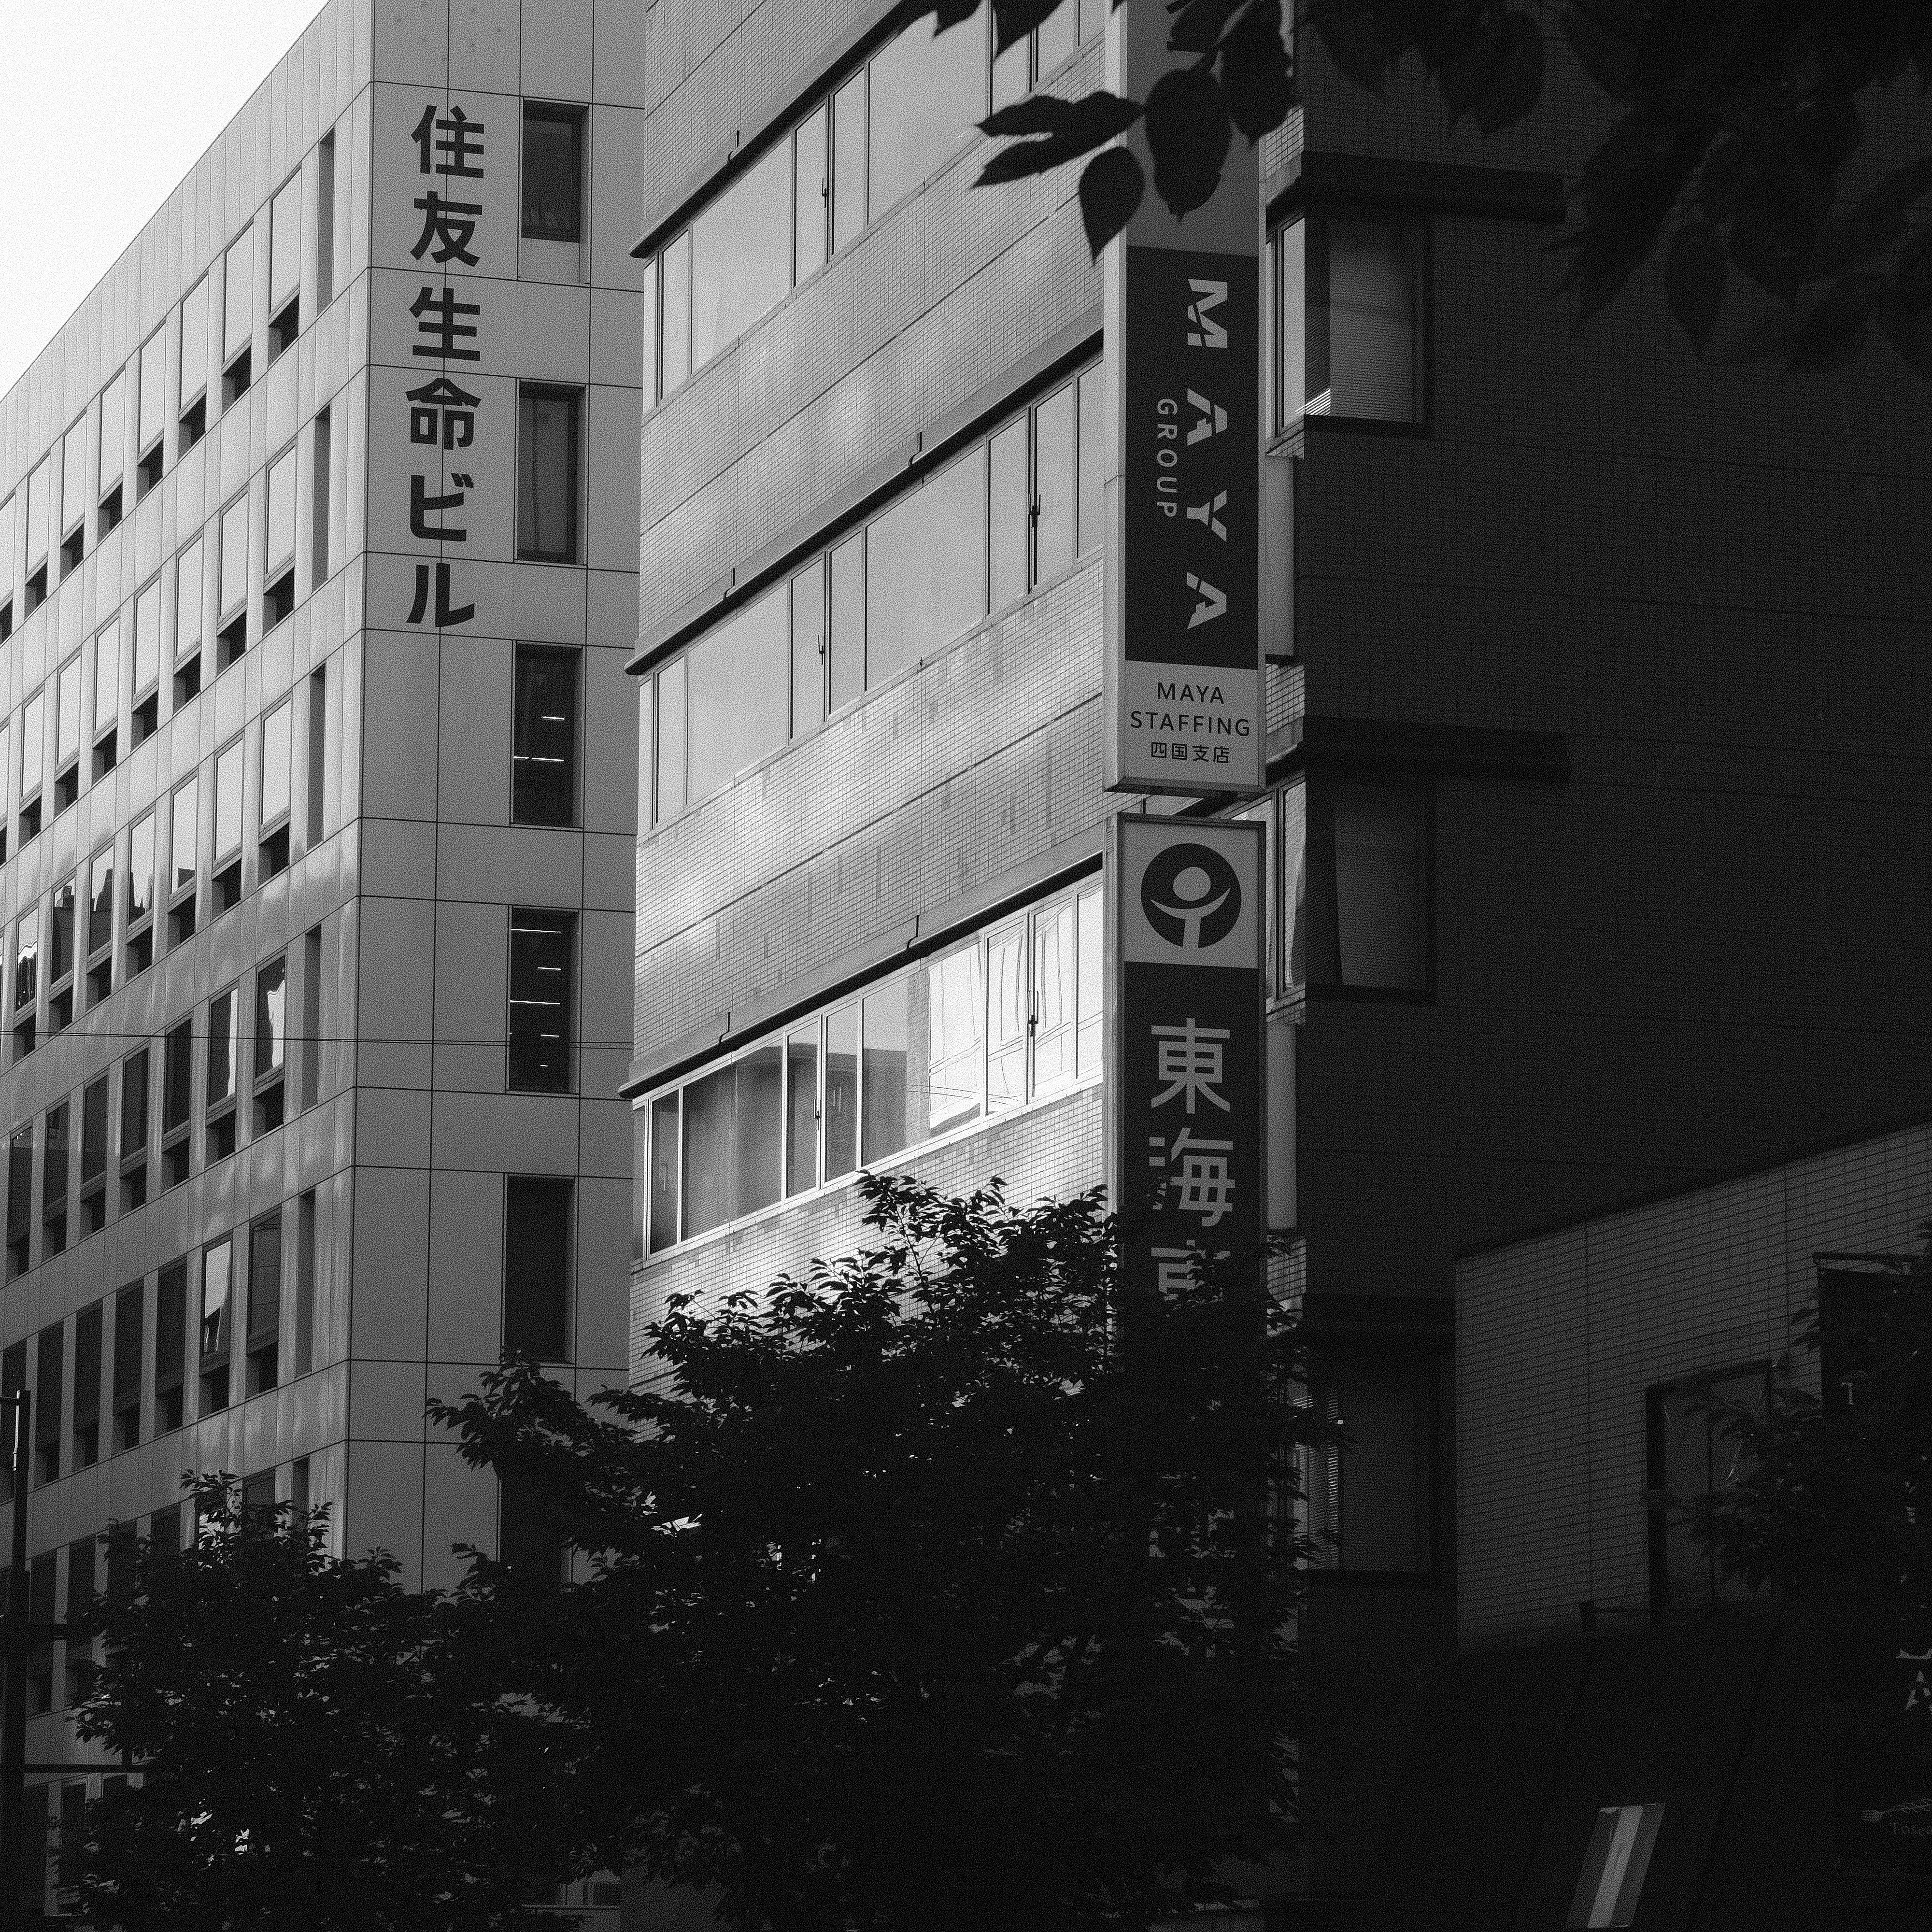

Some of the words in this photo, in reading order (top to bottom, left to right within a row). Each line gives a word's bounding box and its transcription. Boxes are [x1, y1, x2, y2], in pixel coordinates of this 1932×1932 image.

[406, 105, 484, 628] 住友生命ビル
[1156, 398, 1178, 517] GROUP
[1187, 278, 1228, 630] MAYA
[1130, 710, 1250, 736] STAFFING
[1158, 682, 1224, 704] MAYA
[1151, 742, 1230, 764] 四国支店
